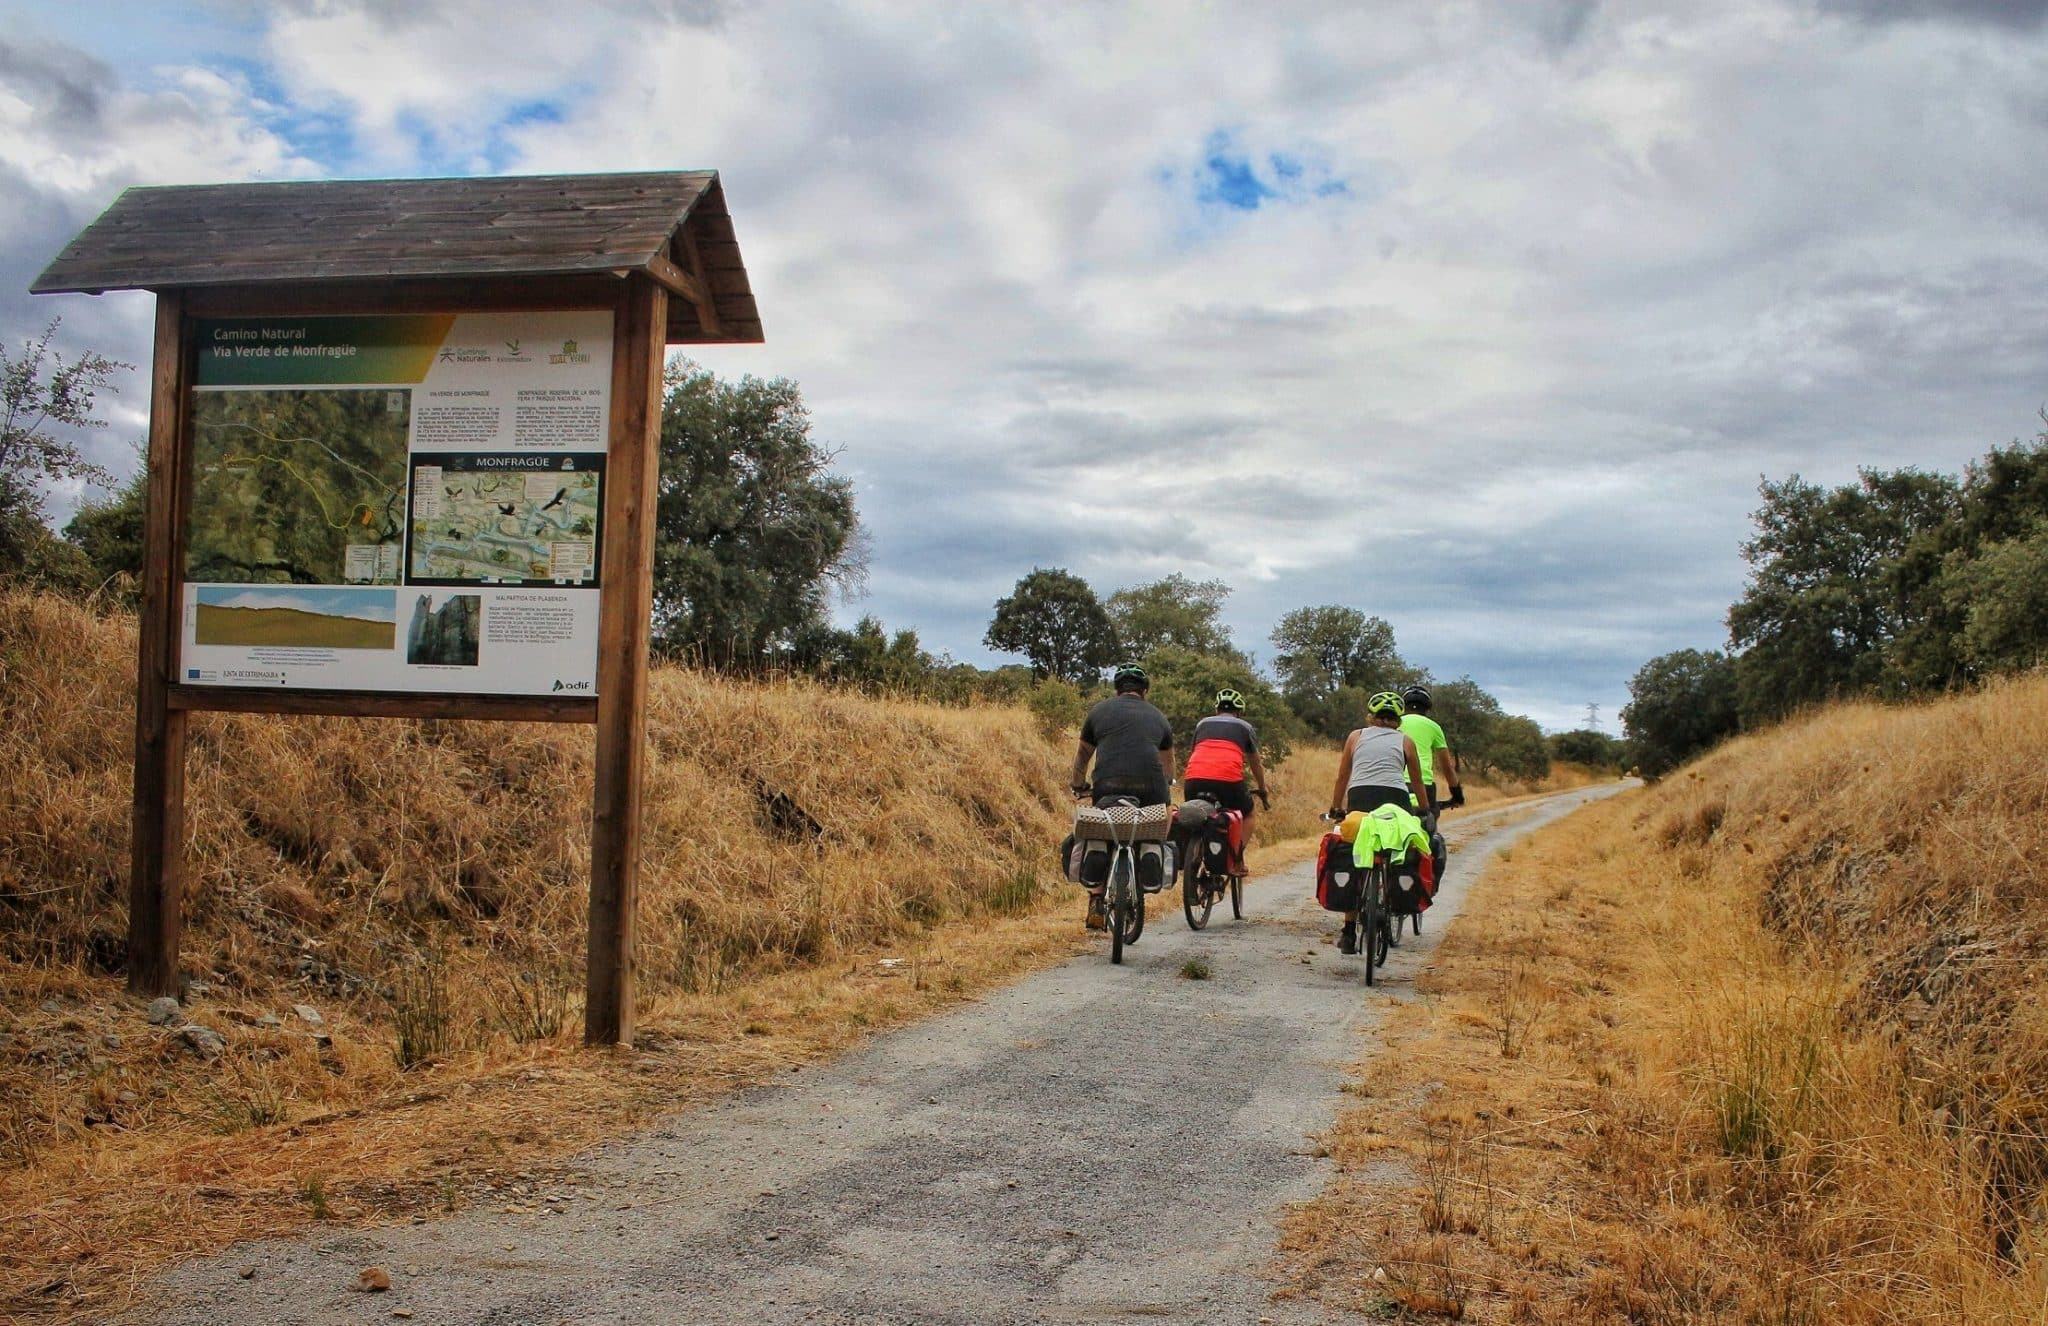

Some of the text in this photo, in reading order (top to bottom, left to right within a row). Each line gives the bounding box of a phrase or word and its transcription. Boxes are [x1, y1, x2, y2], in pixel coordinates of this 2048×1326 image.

[214, 327, 306, 340] Camino Natural
[235, 345, 270, 357] Verde
[274, 345, 289, 357] de
[293, 344, 356, 358] Monfragüe
[476, 457, 550, 466] MONFRAGÜE
[565, 681, 590, 690] adif
